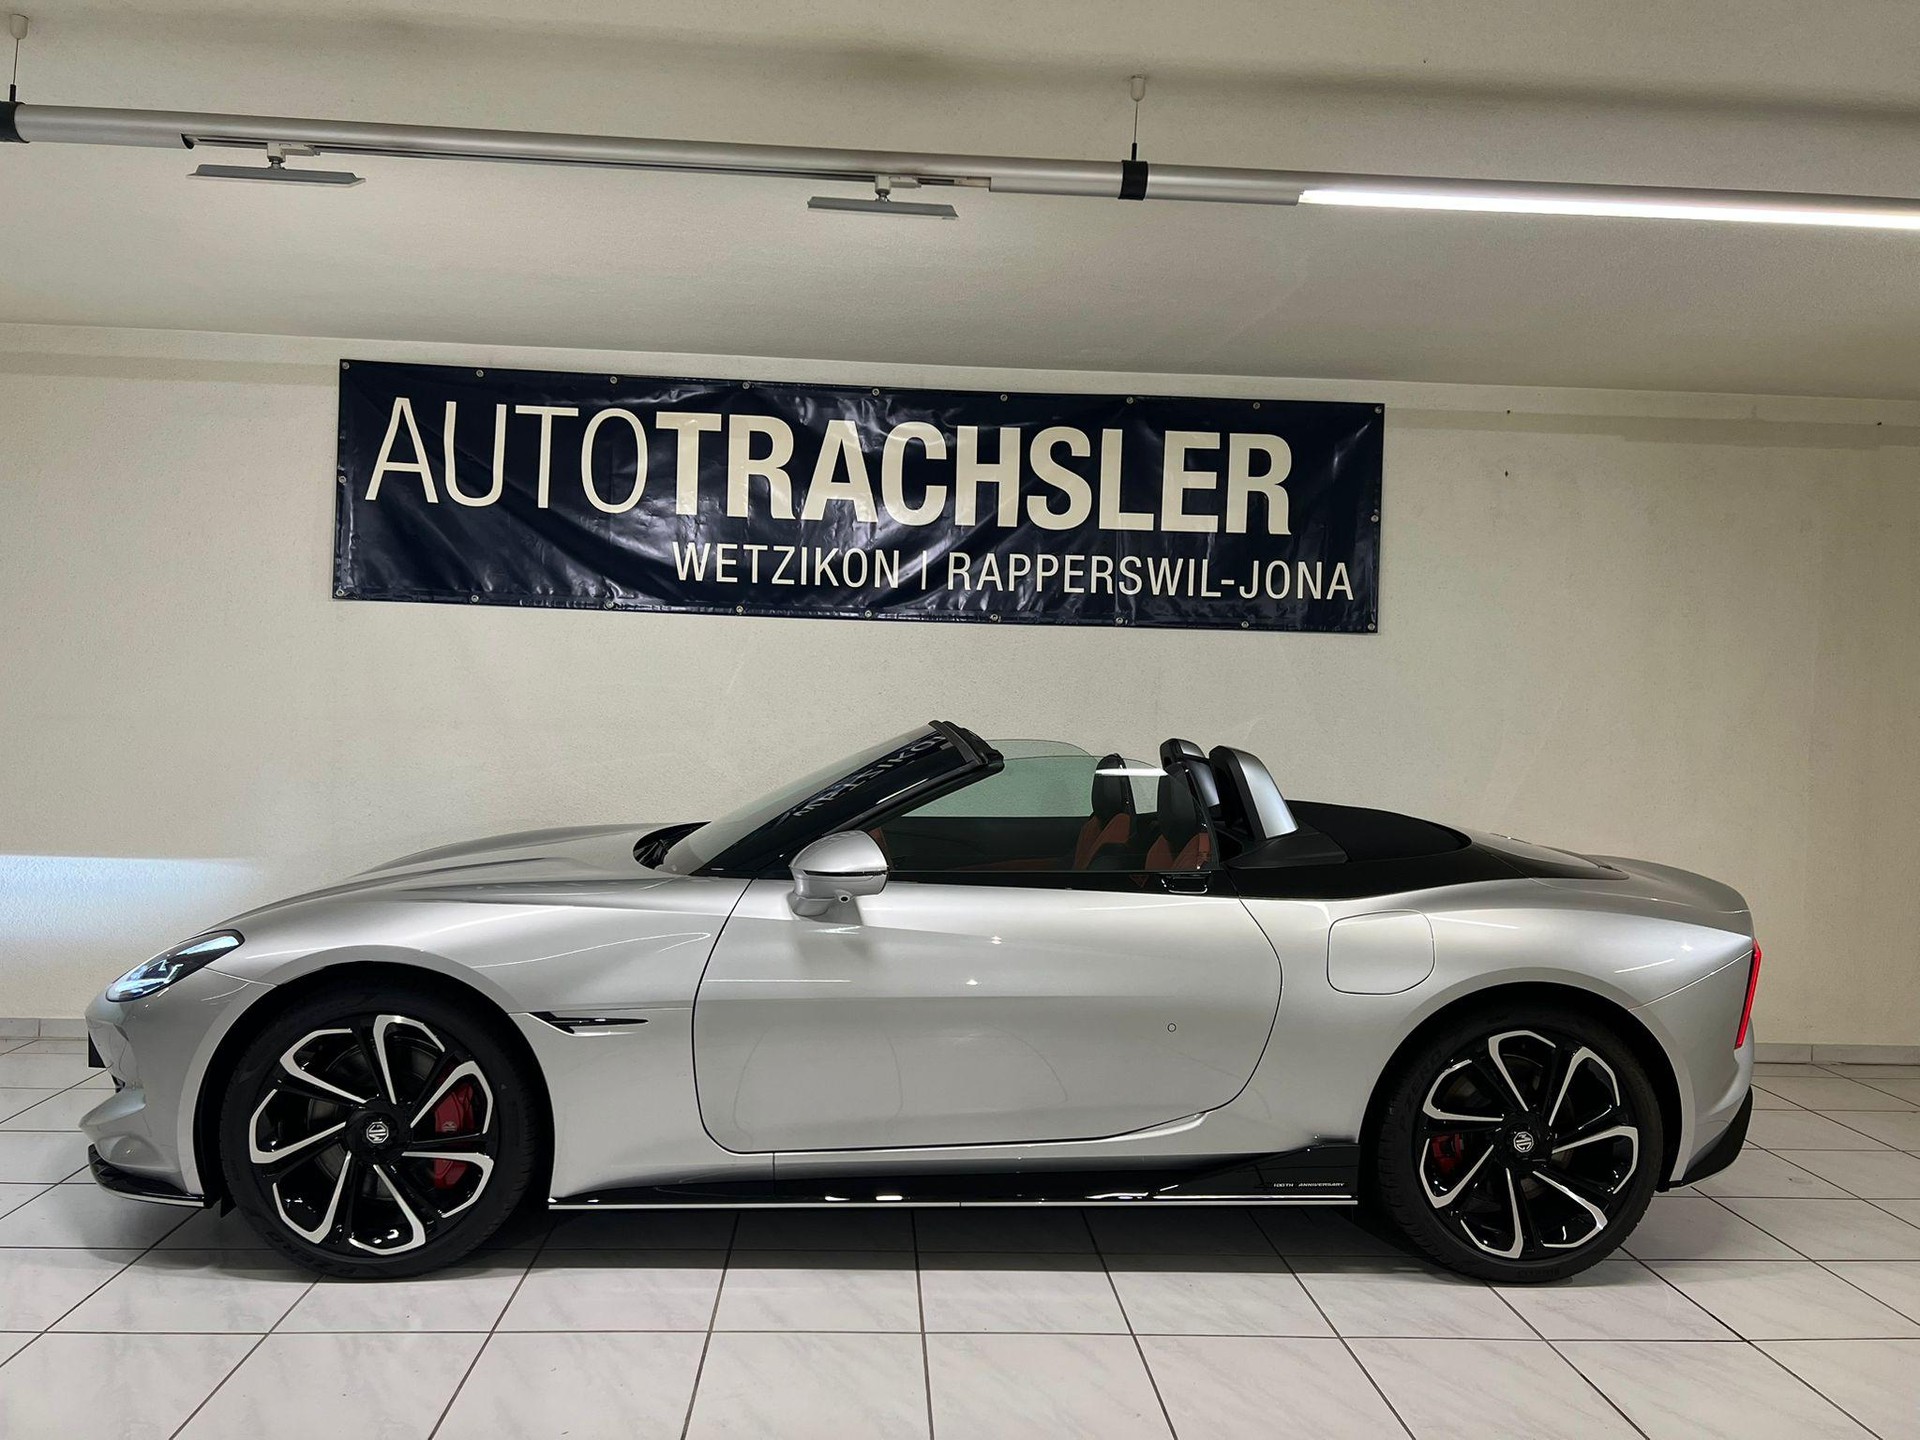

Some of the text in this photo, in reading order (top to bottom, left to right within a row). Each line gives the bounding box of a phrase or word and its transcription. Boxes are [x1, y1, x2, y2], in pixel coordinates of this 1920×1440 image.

[364, 396, 1293, 535] AUTOTRACHSLER
[671, 541, 900, 590] WETZIKON
[946, 552, 1355, 601] RAPPERSWIL-JONA
